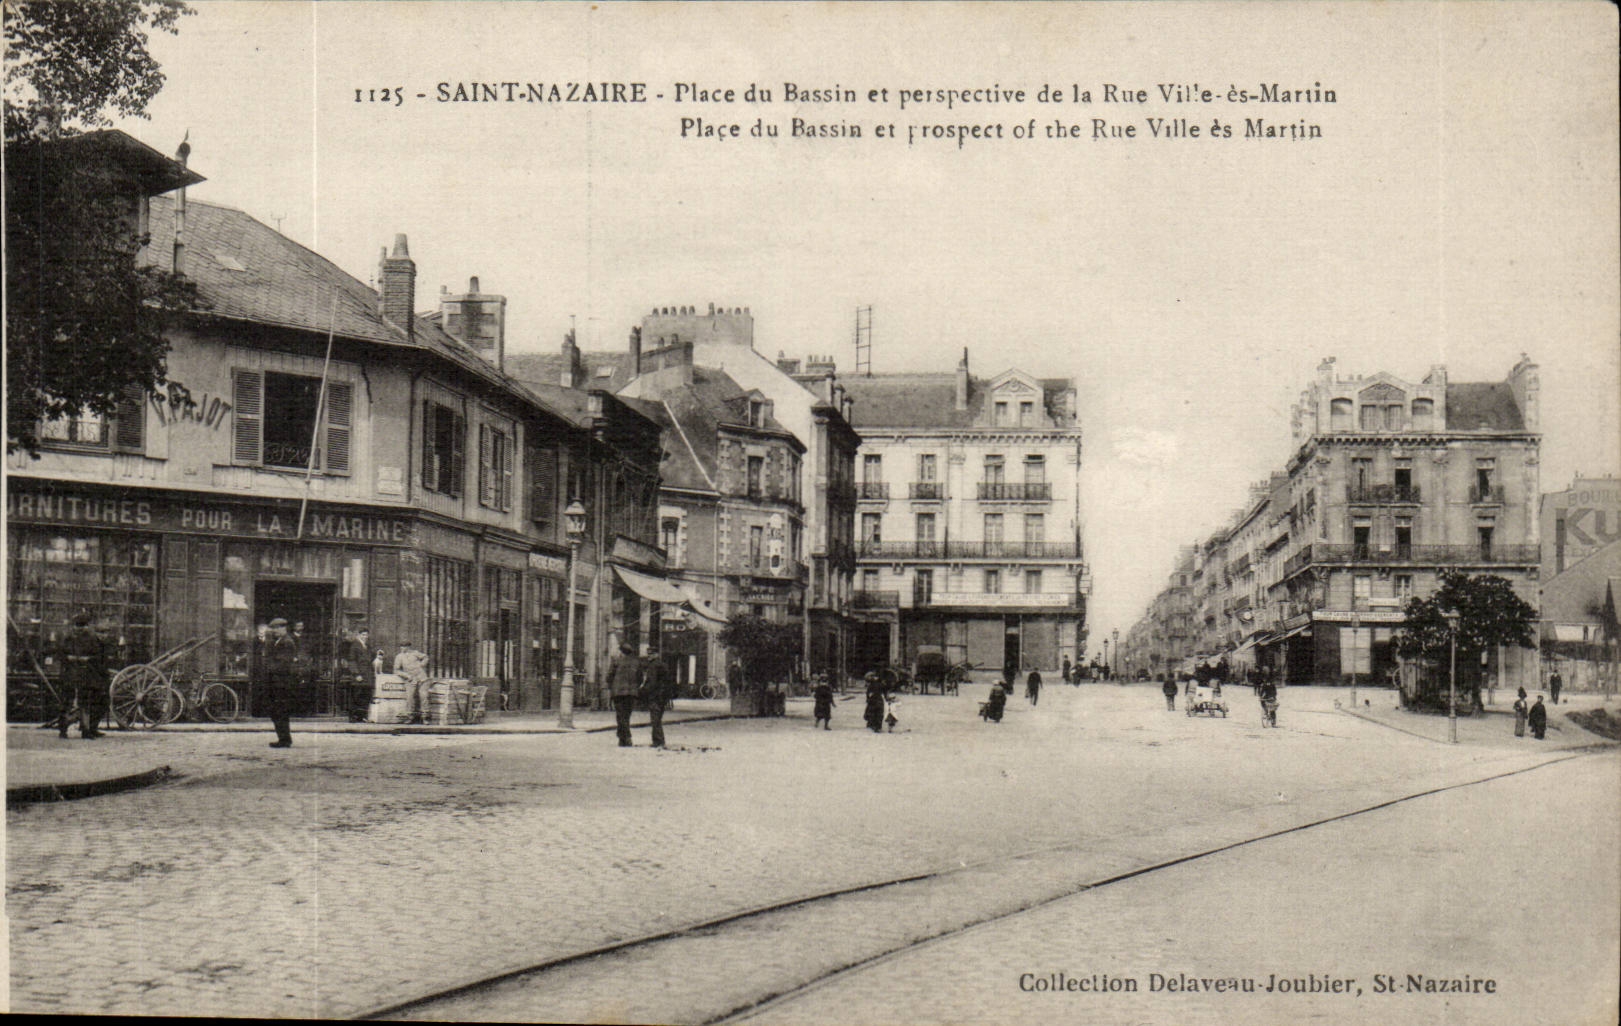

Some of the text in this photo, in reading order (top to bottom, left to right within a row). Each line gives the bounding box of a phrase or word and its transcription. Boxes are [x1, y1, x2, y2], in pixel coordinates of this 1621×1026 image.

[181, 509, 232, 530] POUR
[257, 514, 282, 534] LA
[310, 514, 405, 541] MARINE
